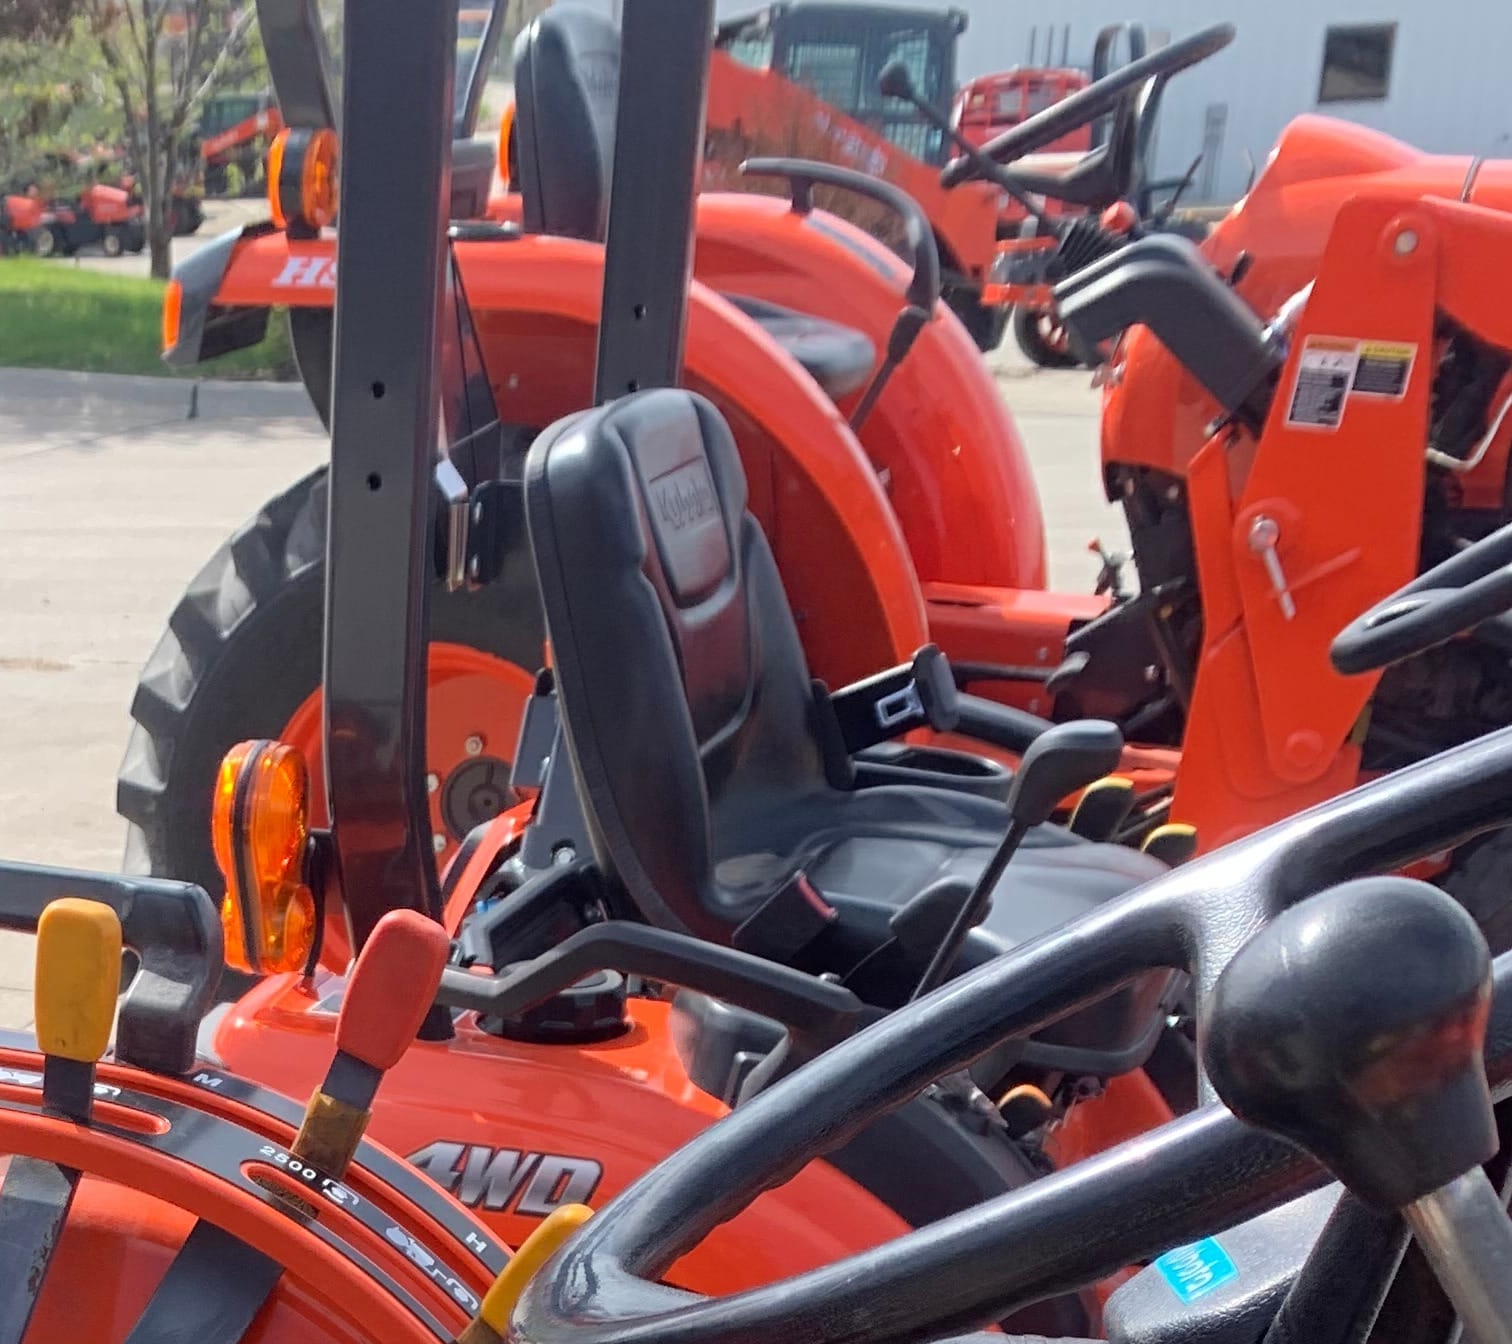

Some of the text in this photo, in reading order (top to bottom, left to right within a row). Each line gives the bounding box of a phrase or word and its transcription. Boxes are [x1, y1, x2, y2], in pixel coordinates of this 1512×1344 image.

[193, 1073, 223, 1087] M
[259, 1145, 317, 1181] 2500
[405, 1139, 604, 1218] 4WD
[465, 1232, 487, 1253] H
